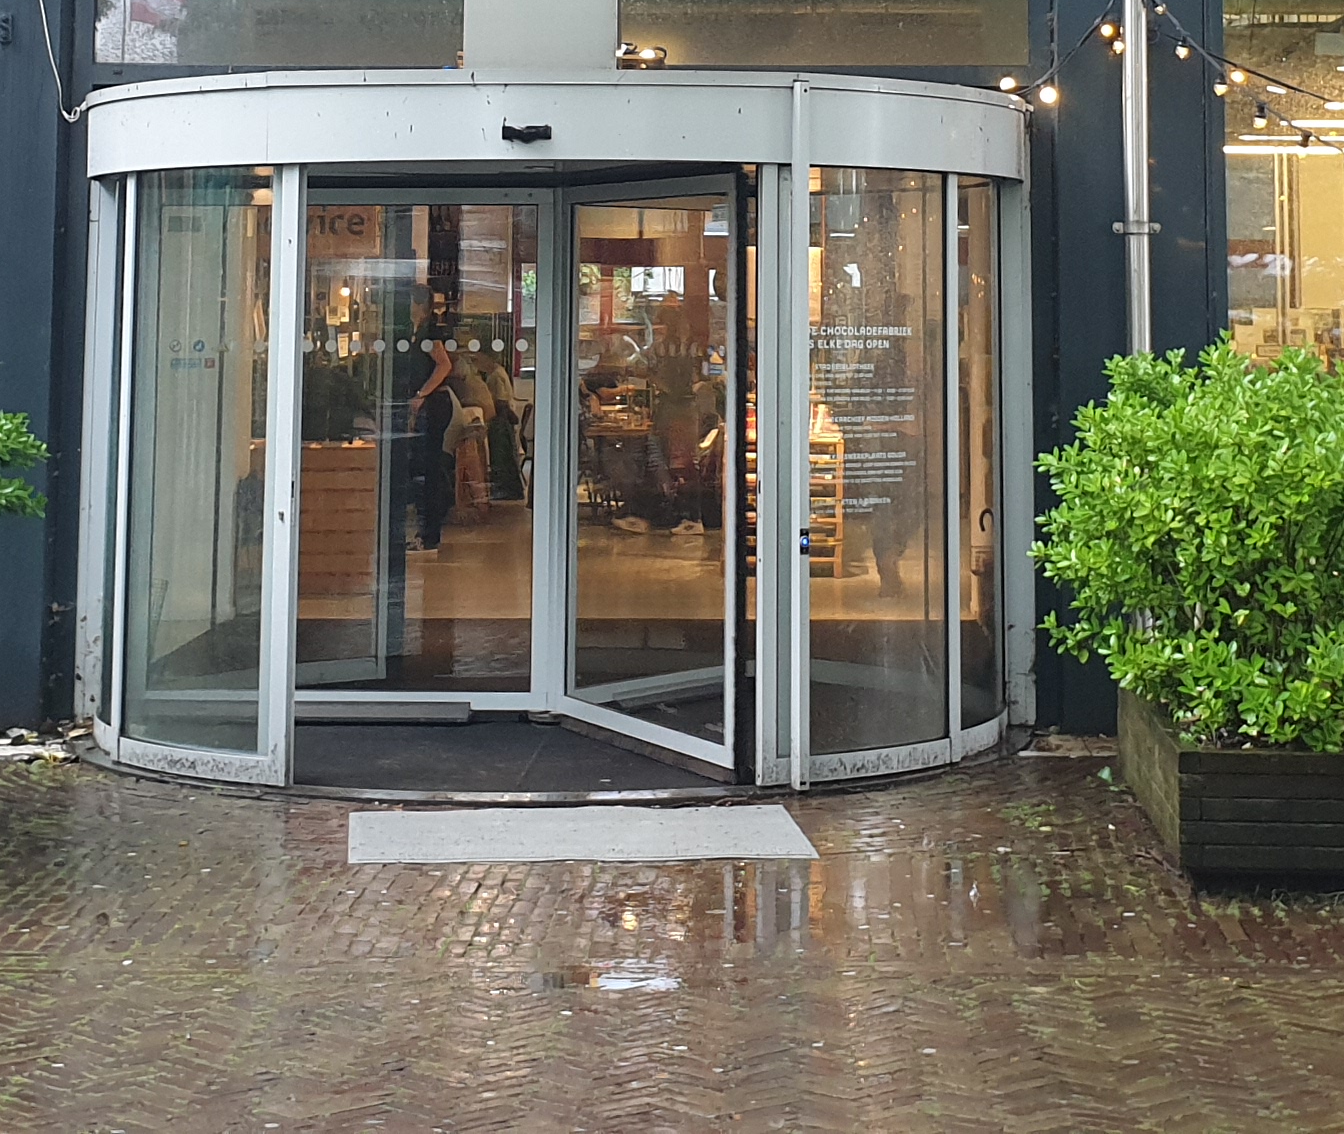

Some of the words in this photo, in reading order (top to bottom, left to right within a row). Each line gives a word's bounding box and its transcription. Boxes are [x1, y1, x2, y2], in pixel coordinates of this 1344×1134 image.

[820, 326, 913, 336] CHOCOLADEFABRIEK
[817, 339, 843, 349] ELKE
[844, 339, 864, 349] DAG
[865, 339, 890, 349] OPEN
